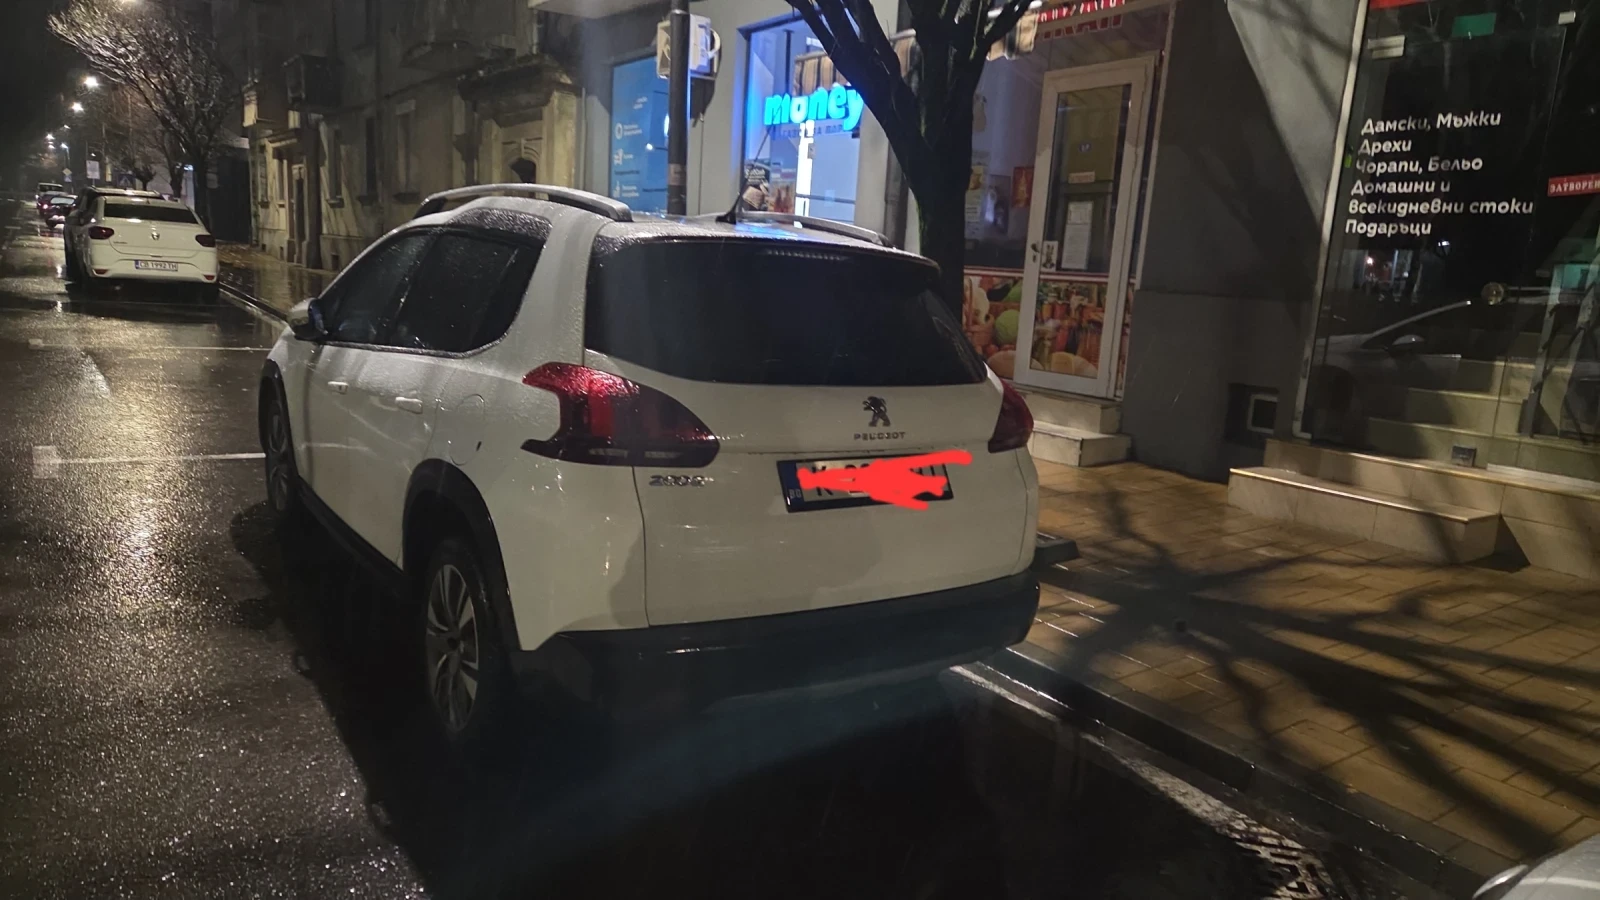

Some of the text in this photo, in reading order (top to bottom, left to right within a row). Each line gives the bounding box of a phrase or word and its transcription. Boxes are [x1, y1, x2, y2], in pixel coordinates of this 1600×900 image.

[764, 83, 864, 131] money
[1360, 110, 1502, 136] Дамски, Мъжки
[1358, 138, 1412, 157] Дрехи
[1355, 156, 1484, 177] Чорапи, Бельо
[1350, 179, 1450, 196] Домашни и
[1469, 197, 1534, 214] стоки
[1345, 218, 1432, 238] Подаръци
[853, 431, 906, 441] PEUGEOT
